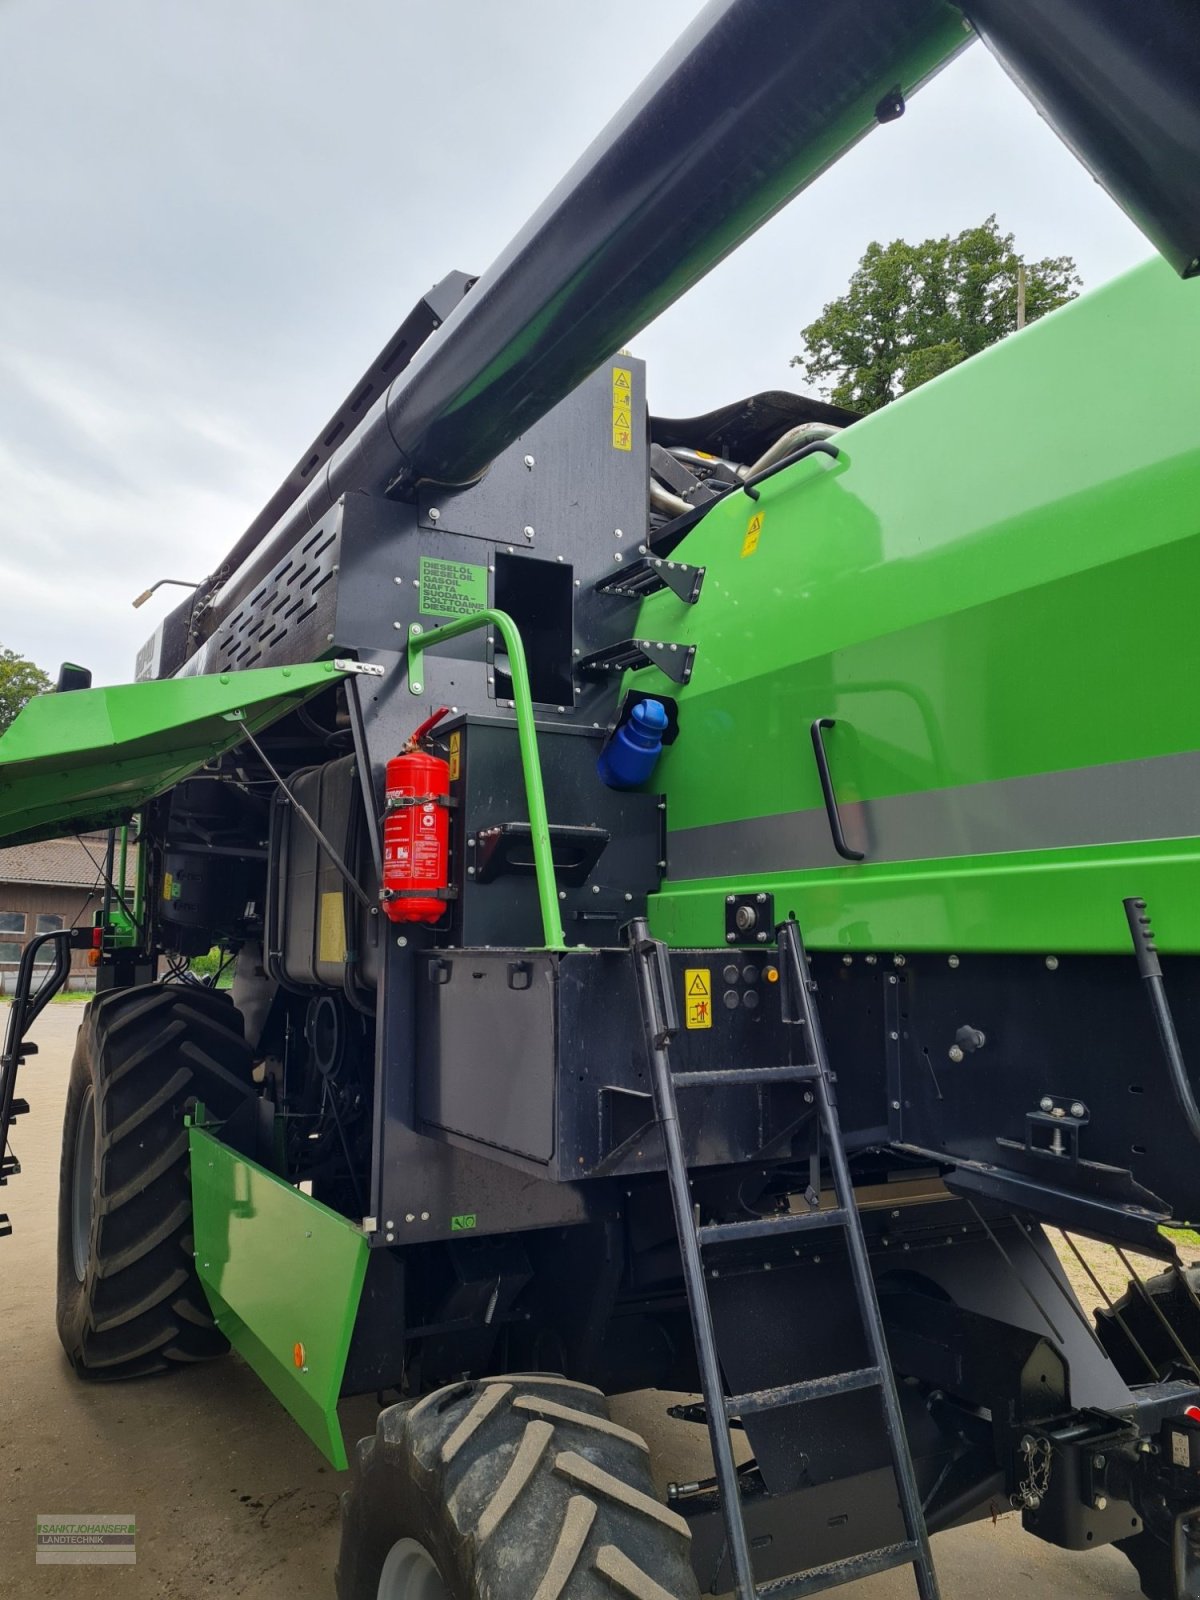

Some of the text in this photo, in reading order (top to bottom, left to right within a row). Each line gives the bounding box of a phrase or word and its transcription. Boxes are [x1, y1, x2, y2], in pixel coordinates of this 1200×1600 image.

[424, 568, 475, 582] DIESELOIL
[424, 575, 461, 587] GASOIL
[423, 582, 456, 592] NAFTA
[423, 596, 484, 610] POLTTOAINE
